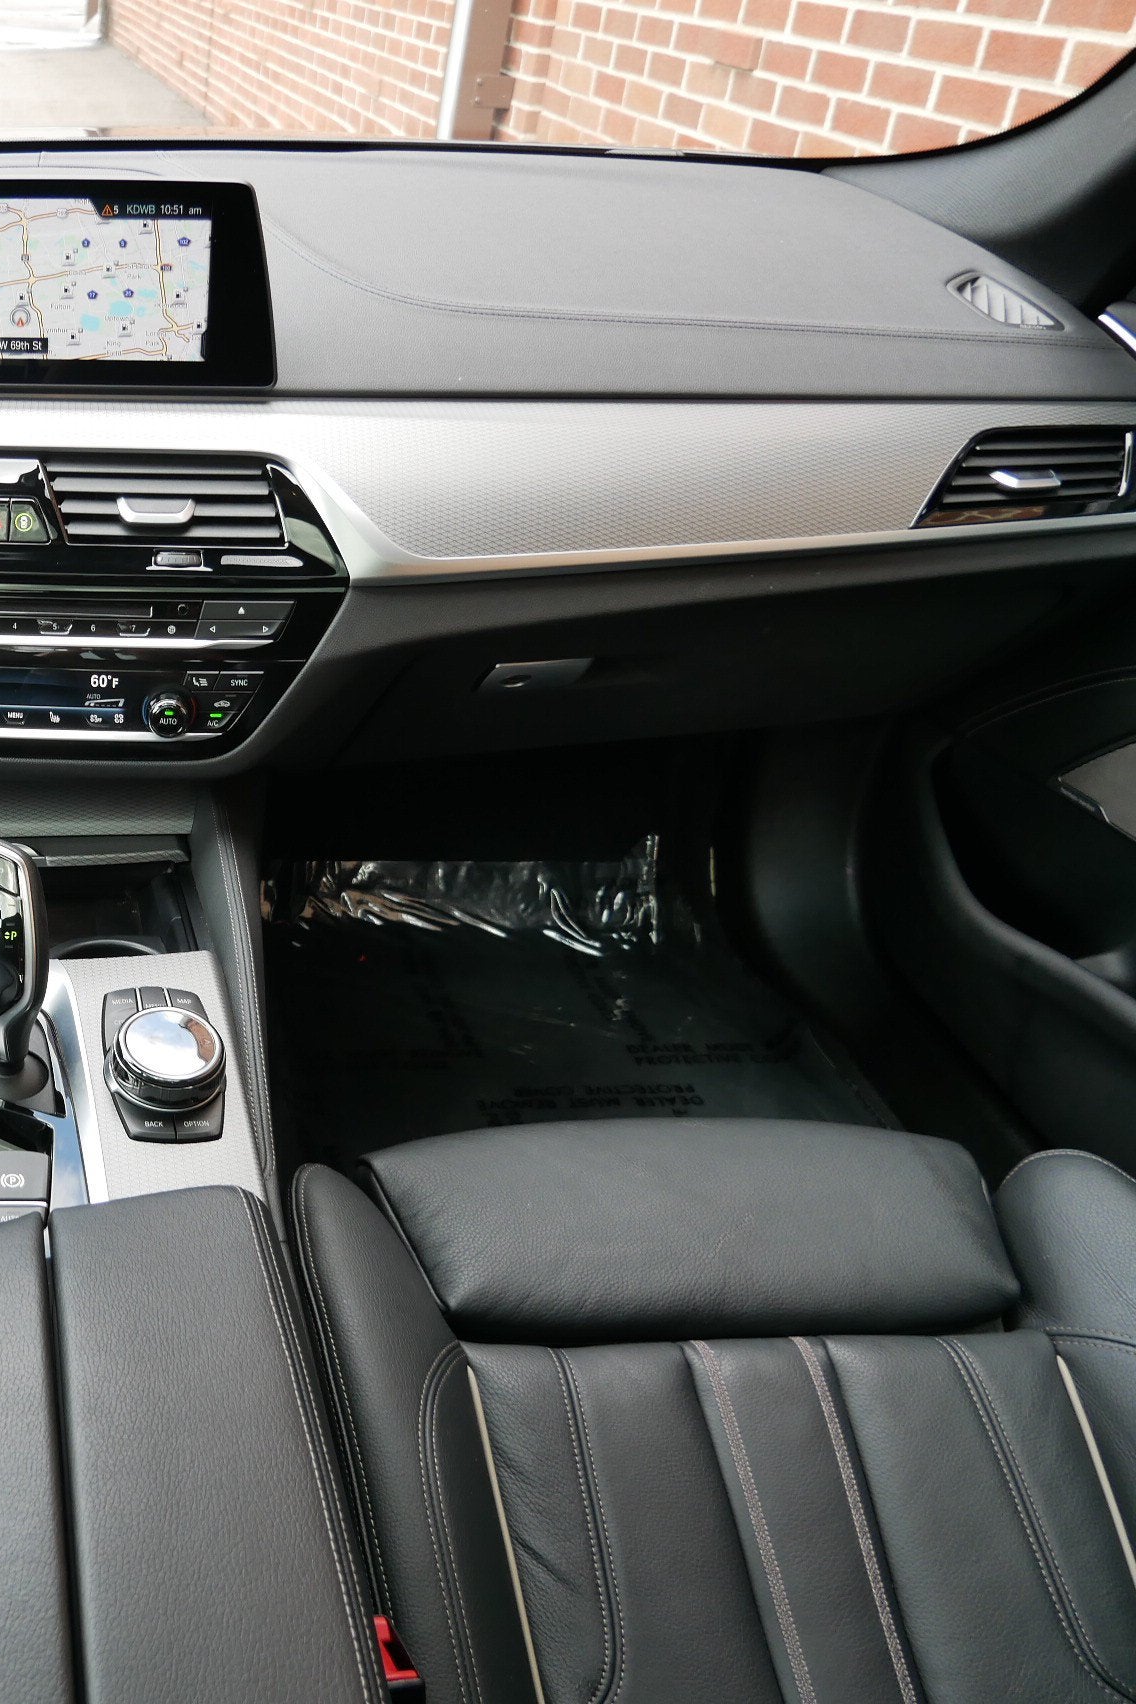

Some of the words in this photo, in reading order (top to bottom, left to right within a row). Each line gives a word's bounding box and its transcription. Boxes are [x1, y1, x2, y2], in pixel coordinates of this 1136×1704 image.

[126, 205, 156, 214] KDWB
[160, 205, 183, 214] 10:51
[188, 207, 202, 215] am
[0, 340, 9, 350] W
[11, 340, 31, 351] 69th
[32, 341, 43, 351] St
[230, 678, 248, 687] SYNC
[7, 711, 24, 719] MENU
[159, 717, 178, 725] AUTO
[207, 719, 219, 727] A/C
[144, 1120, 164, 1128] BACK
[183, 1120, 210, 1128] OPTION
